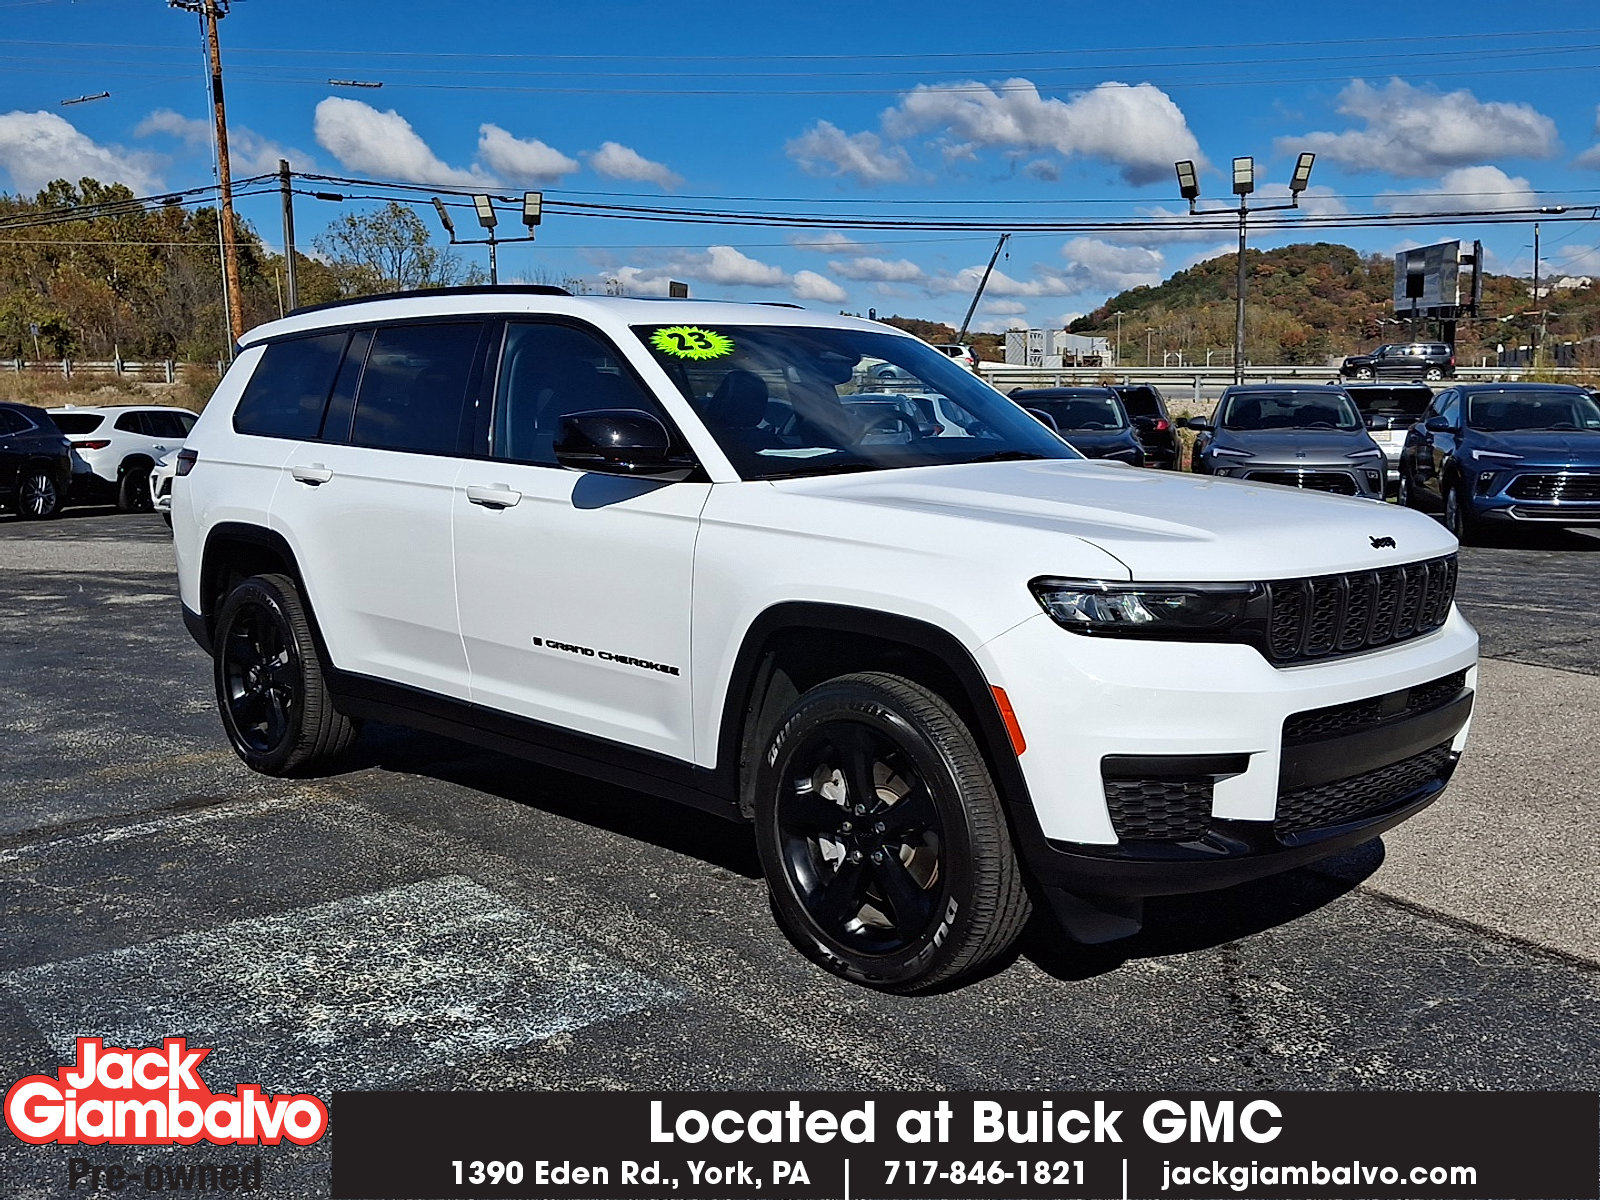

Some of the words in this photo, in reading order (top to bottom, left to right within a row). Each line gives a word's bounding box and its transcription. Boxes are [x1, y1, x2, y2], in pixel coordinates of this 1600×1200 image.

[666, 332, 713, 351] 23
[545, 639, 595, 657] GRAND
[598, 651, 680, 676] CHEROKEE
